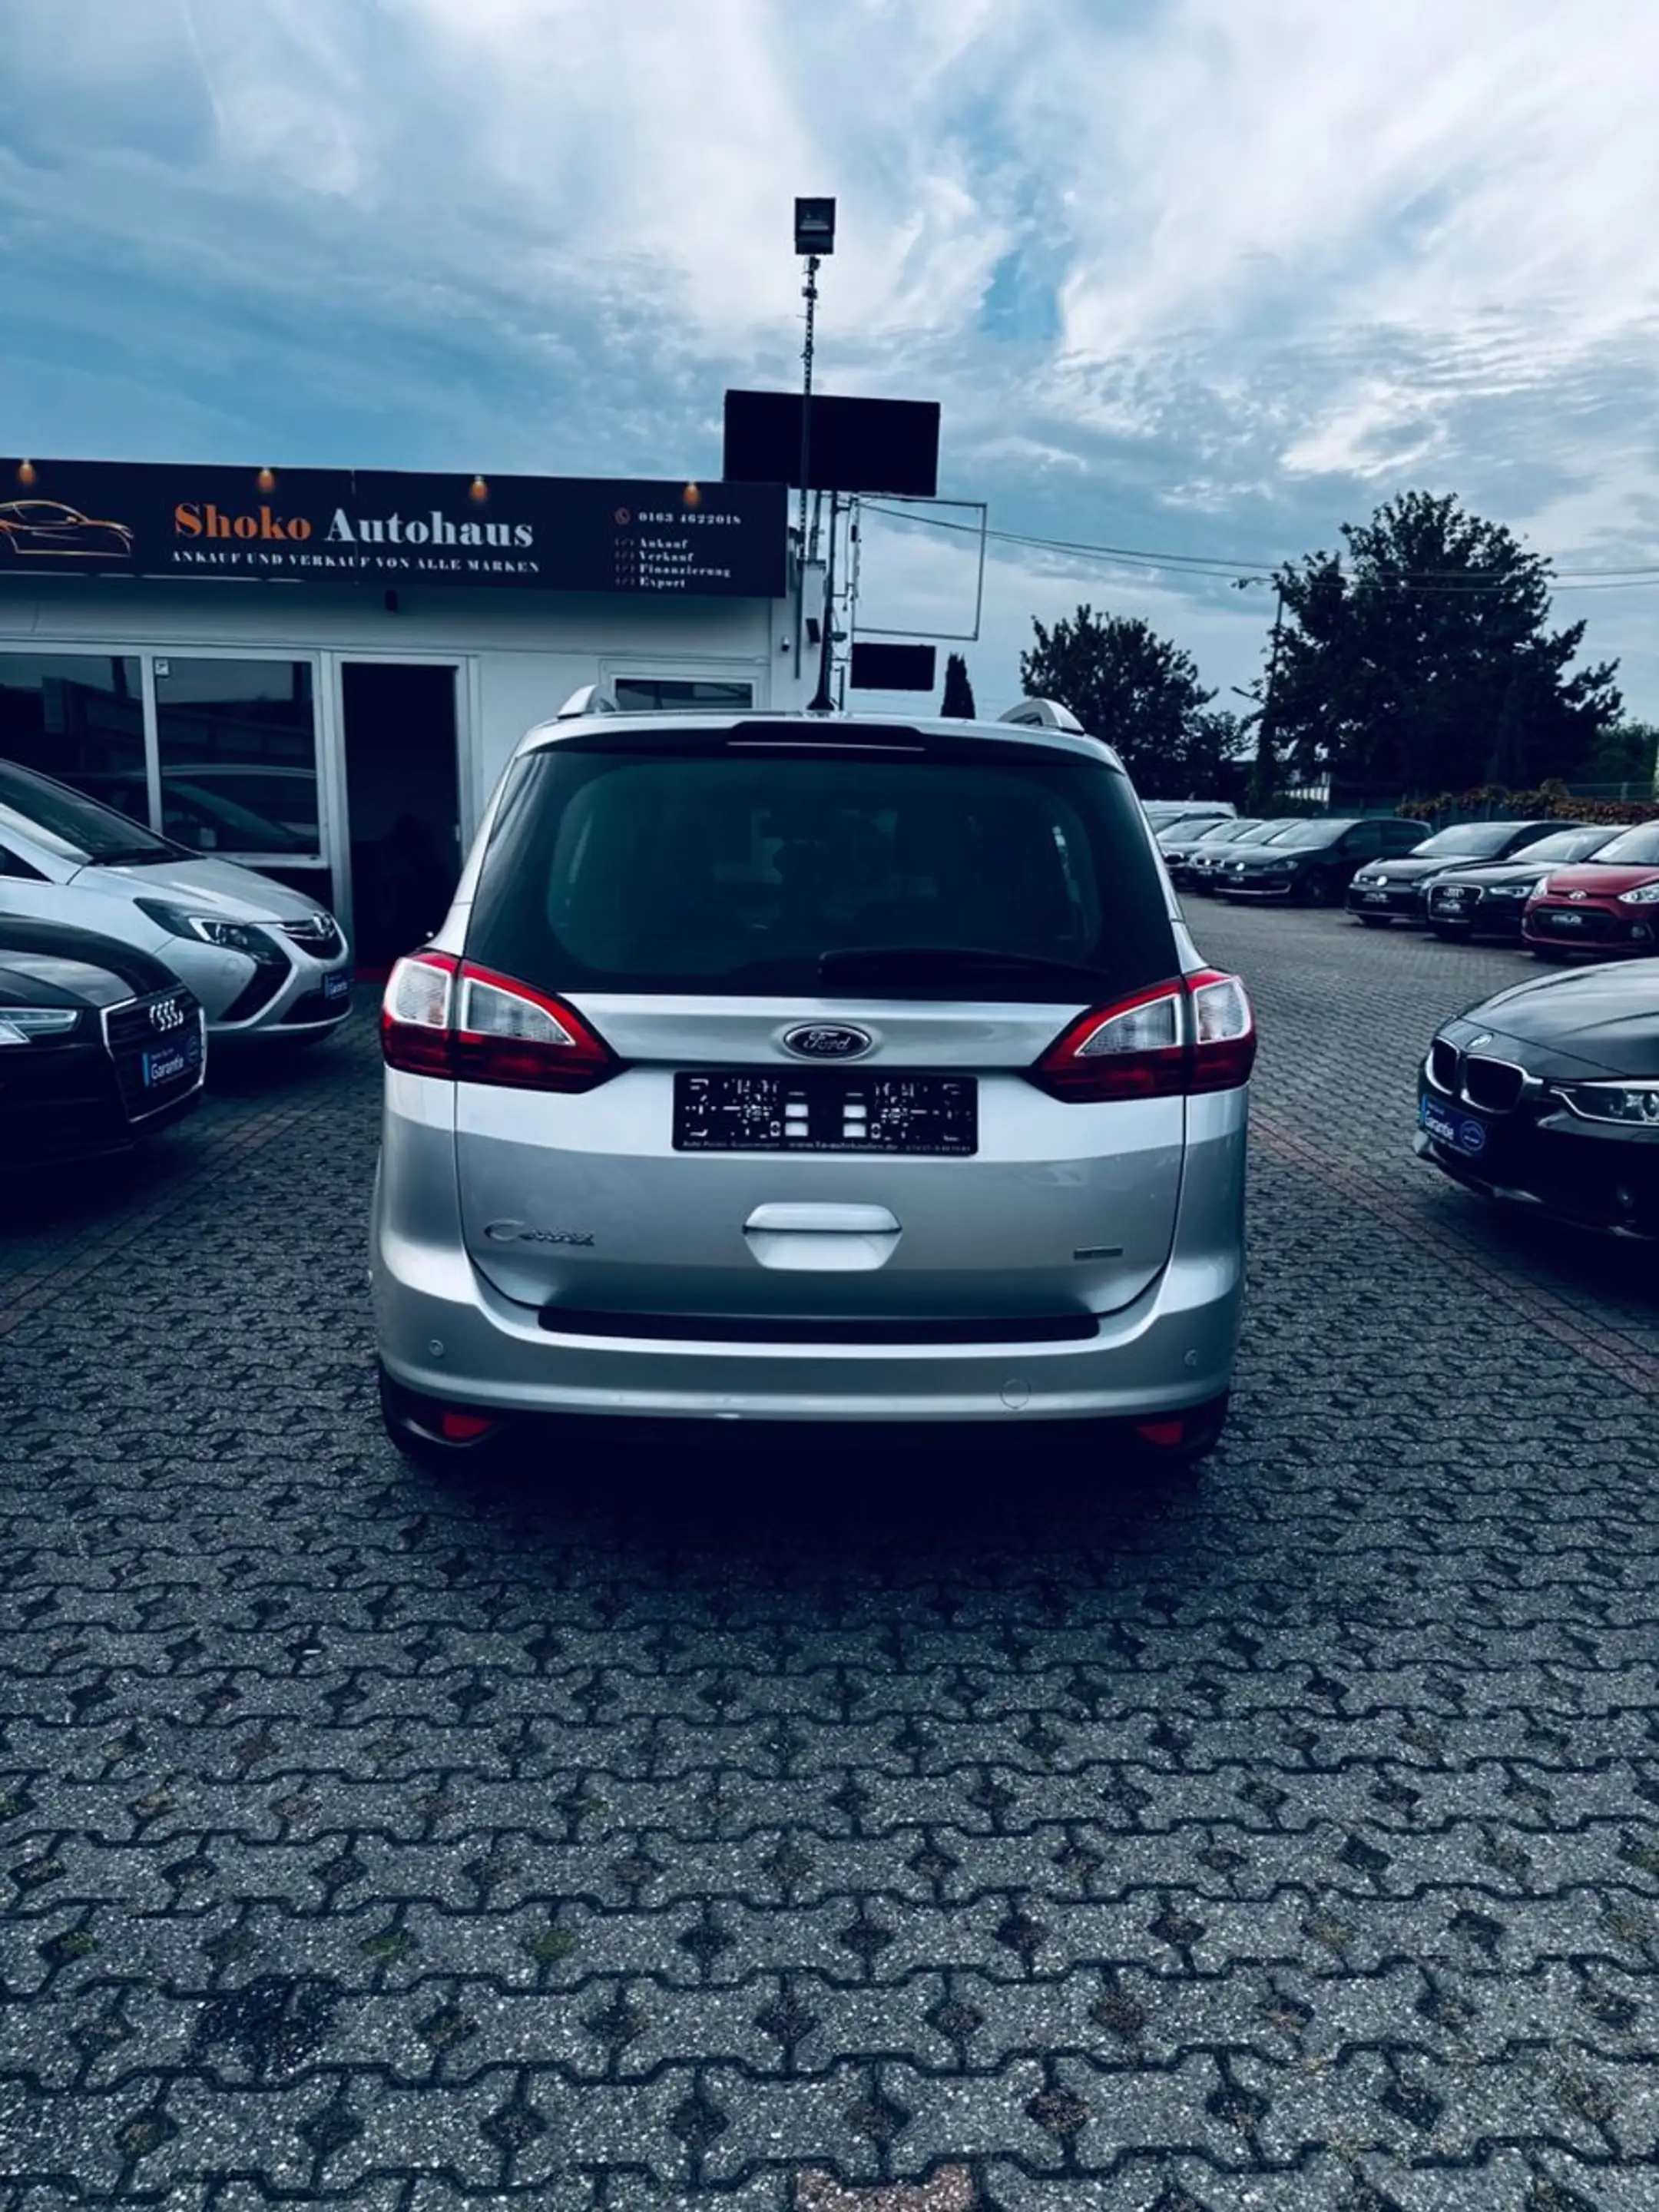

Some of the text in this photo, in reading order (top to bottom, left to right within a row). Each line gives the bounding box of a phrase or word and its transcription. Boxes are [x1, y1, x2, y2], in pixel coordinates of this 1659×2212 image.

[174, 503, 534, 548] Shoko Autohaus
[640, 538, 689, 549] Ankauf
[171, 551, 540, 572] ANKAUF UND VERKAUF VON ALLE MARKEN
[639, 550, 694, 562] Verkauf
[639, 564, 731, 578] Finanzierung
[640, 576, 686, 589] Export
[803, 1031, 851, 1050] Ford
